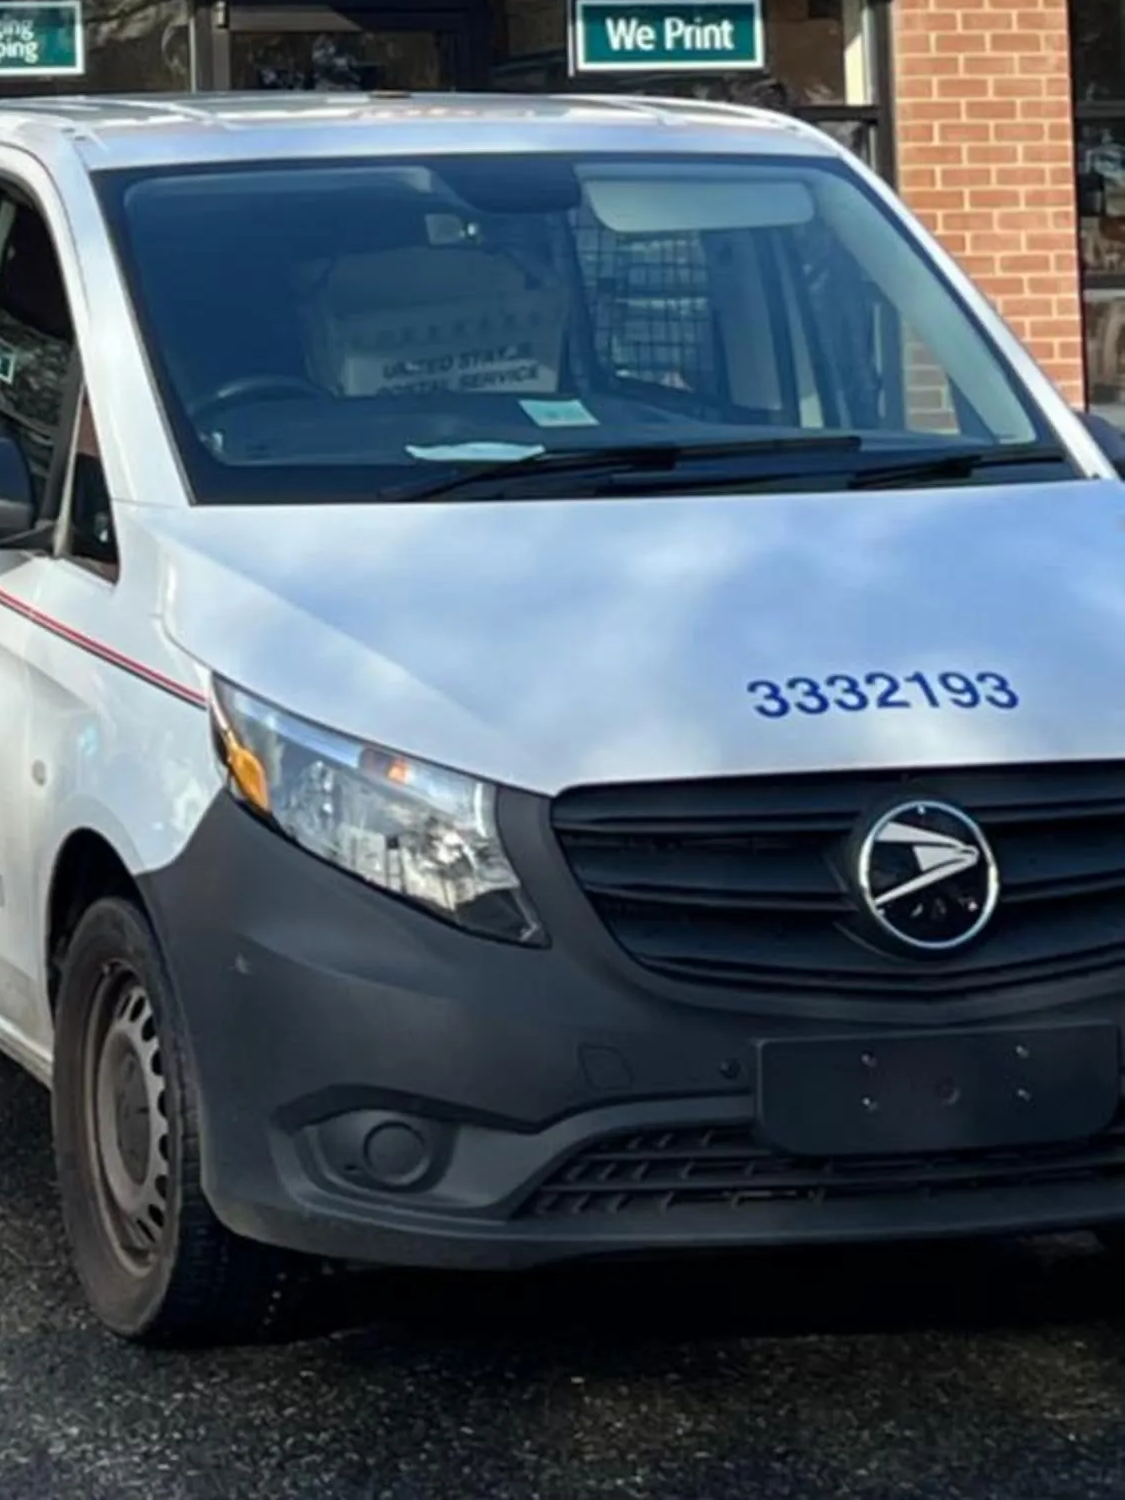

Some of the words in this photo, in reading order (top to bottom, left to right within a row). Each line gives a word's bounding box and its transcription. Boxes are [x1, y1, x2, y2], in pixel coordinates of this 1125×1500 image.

[605, 17, 657, 51] We
[664, 17, 734, 51] Print
[459, 342, 532, 370] STATS
[459, 364, 539, 389] SERVICE
[747, 671, 1020, 718] 3332193
